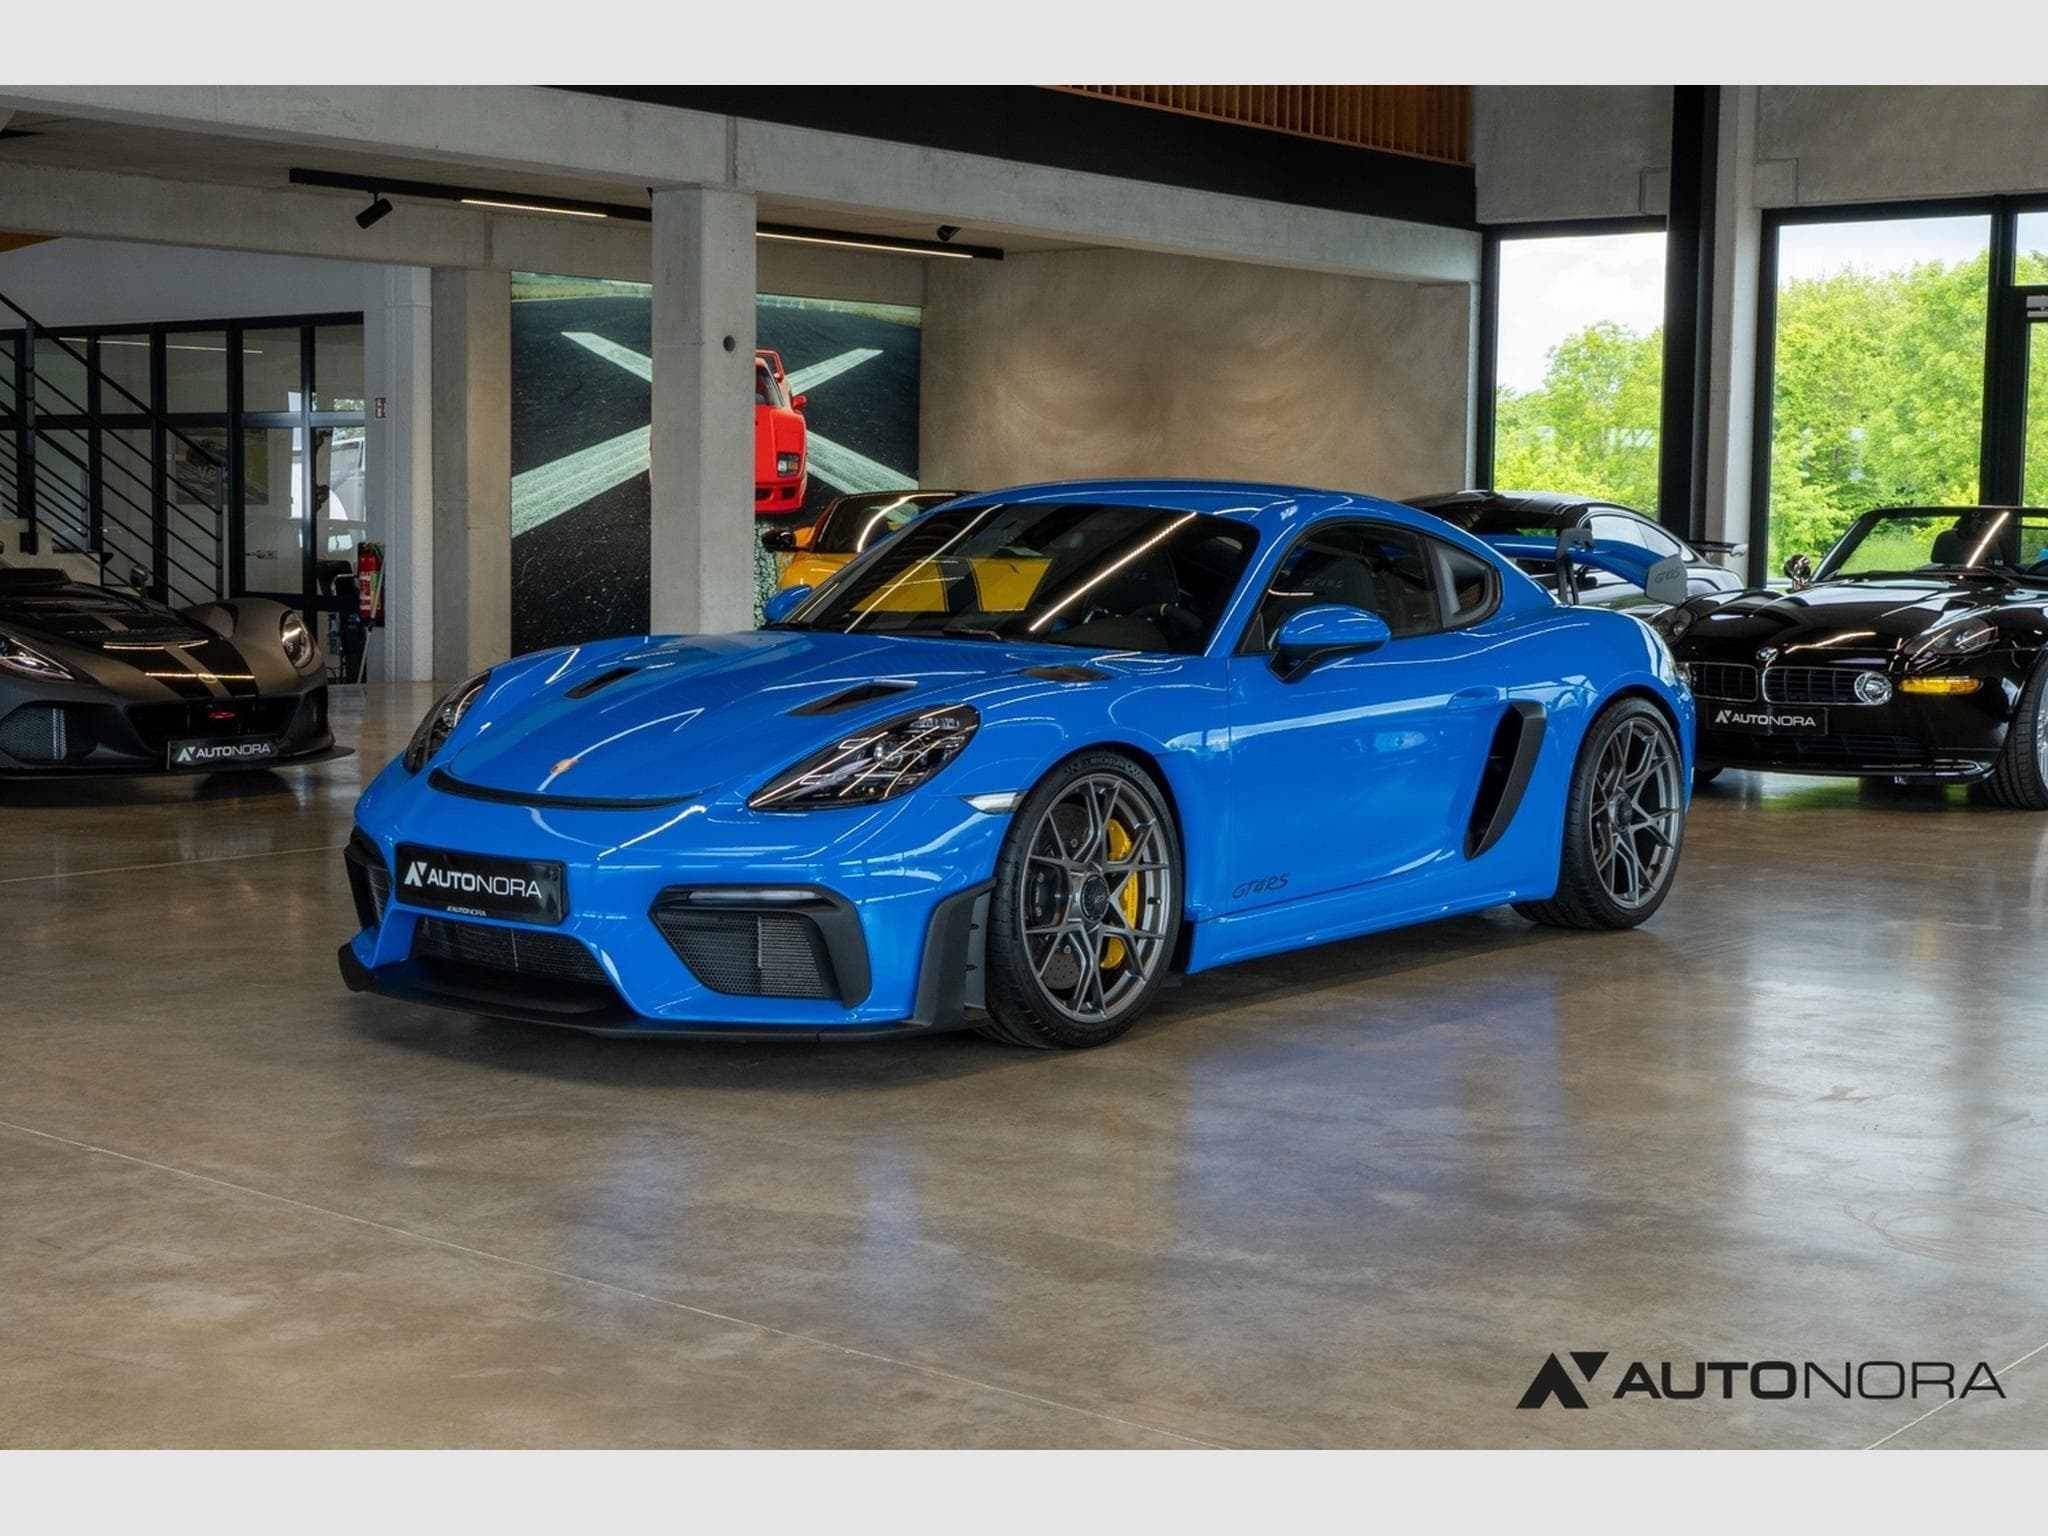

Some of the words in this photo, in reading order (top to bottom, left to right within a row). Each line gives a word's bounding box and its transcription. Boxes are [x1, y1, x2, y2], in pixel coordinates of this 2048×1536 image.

[1731, 712, 1816, 727] AUTONORA
[196, 743, 271, 759] AUTONORA
[427, 867, 543, 899] AUTONORA
